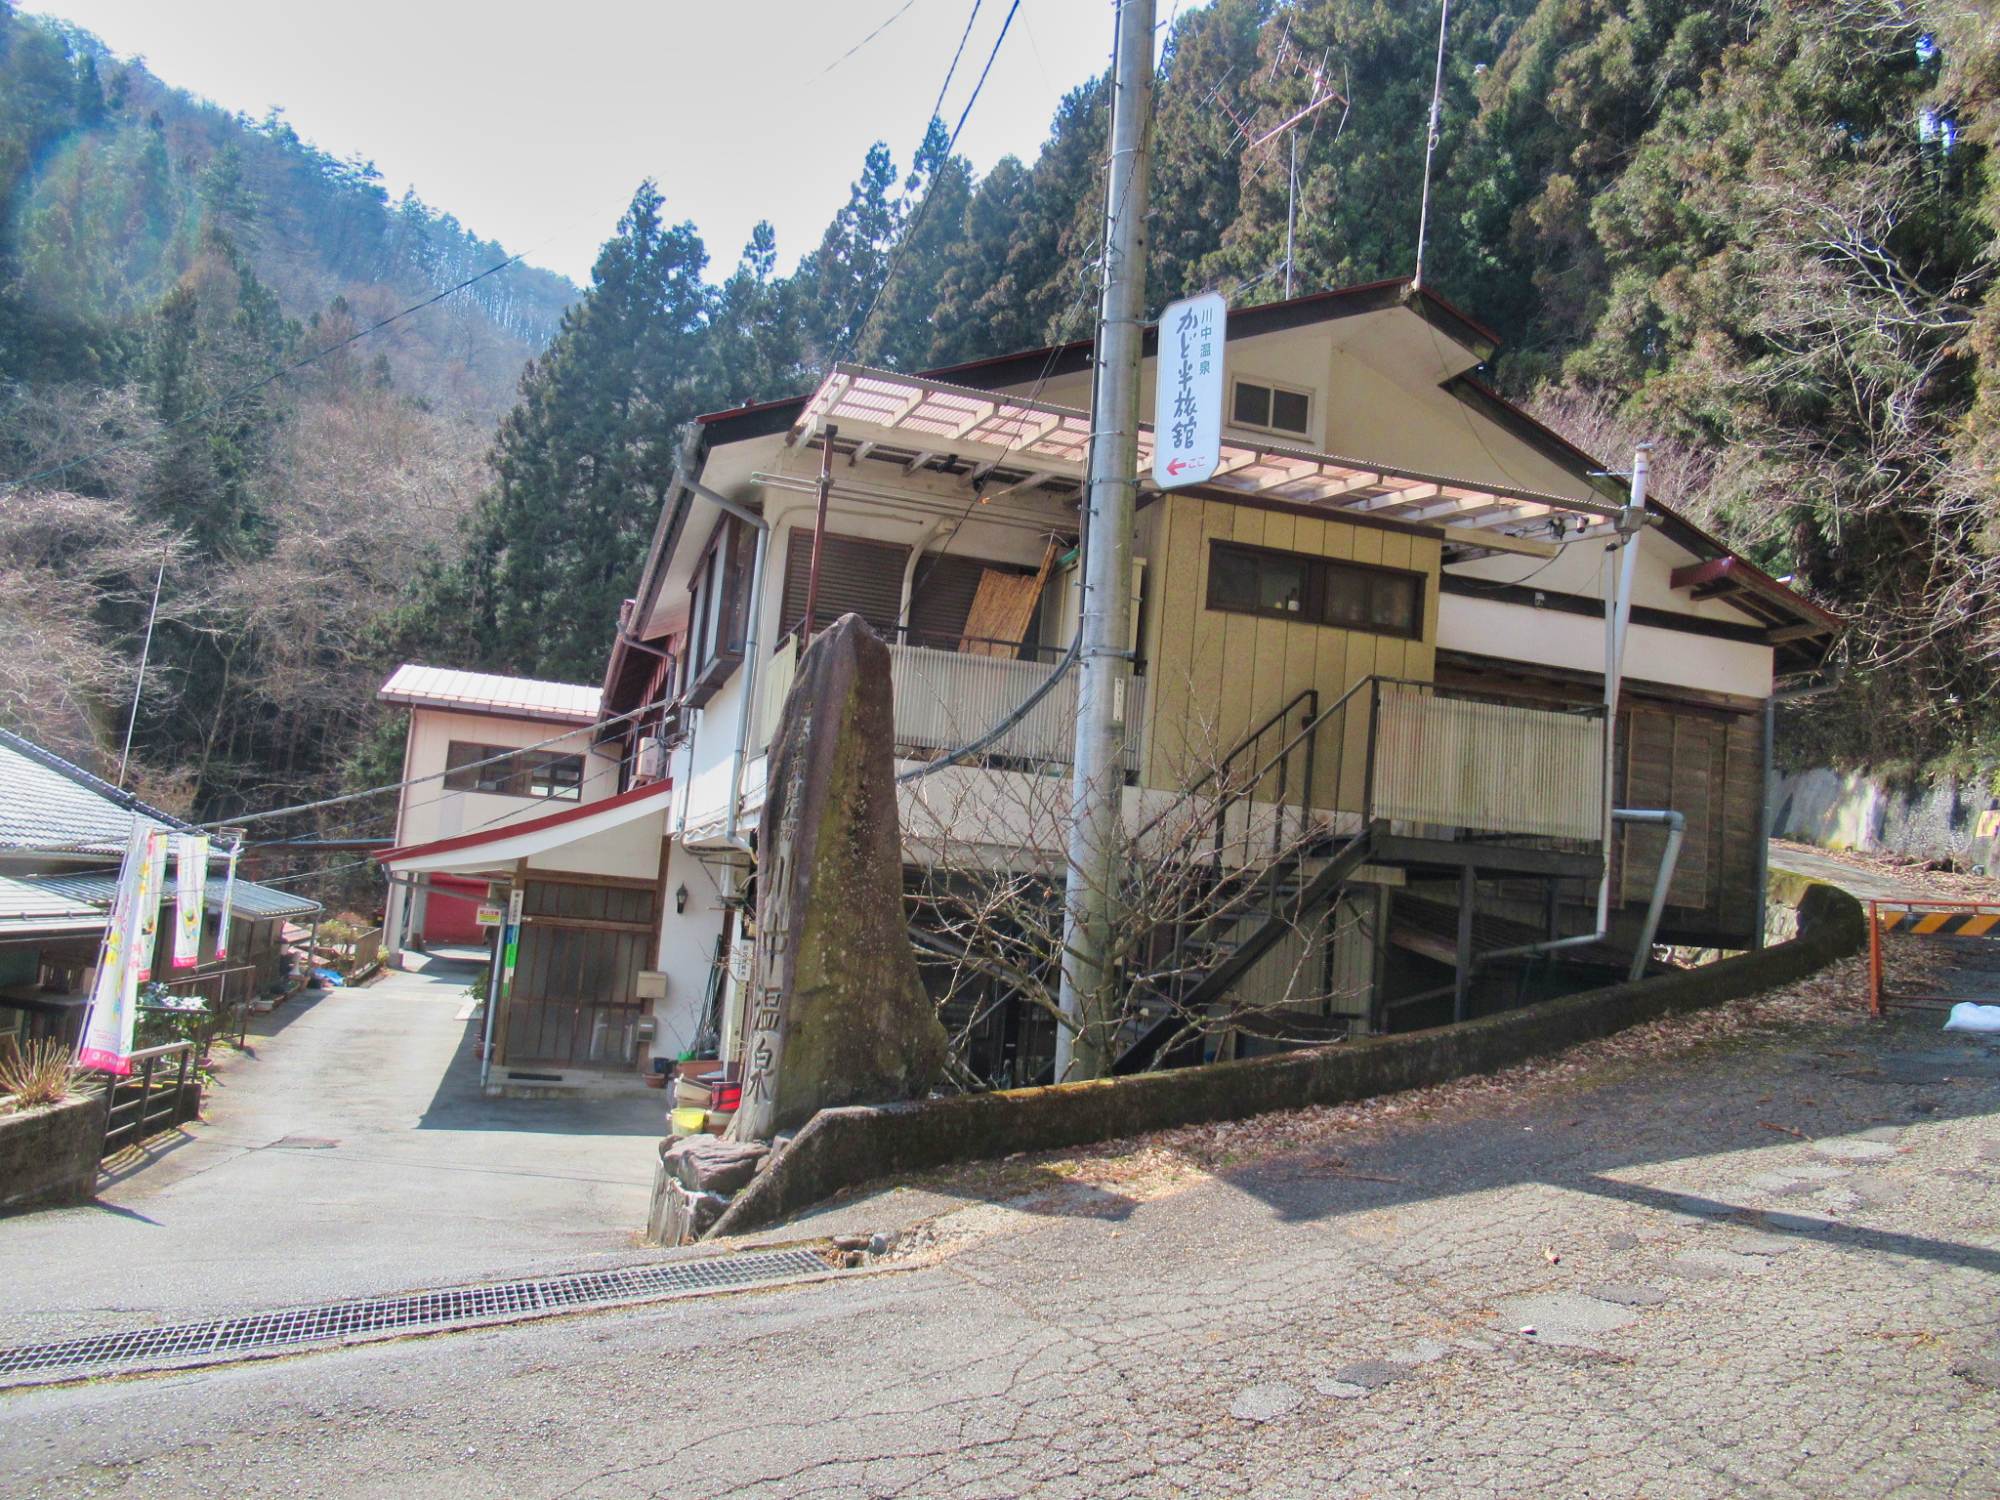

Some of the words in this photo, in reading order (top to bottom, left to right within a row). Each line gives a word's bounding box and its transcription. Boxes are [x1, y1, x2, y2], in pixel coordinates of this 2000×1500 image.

[1199, 307, 1213, 376] 川中温泉
[1188, 456, 1205, 469] ここ
[746, 855, 794, 1104] 川中温泉
